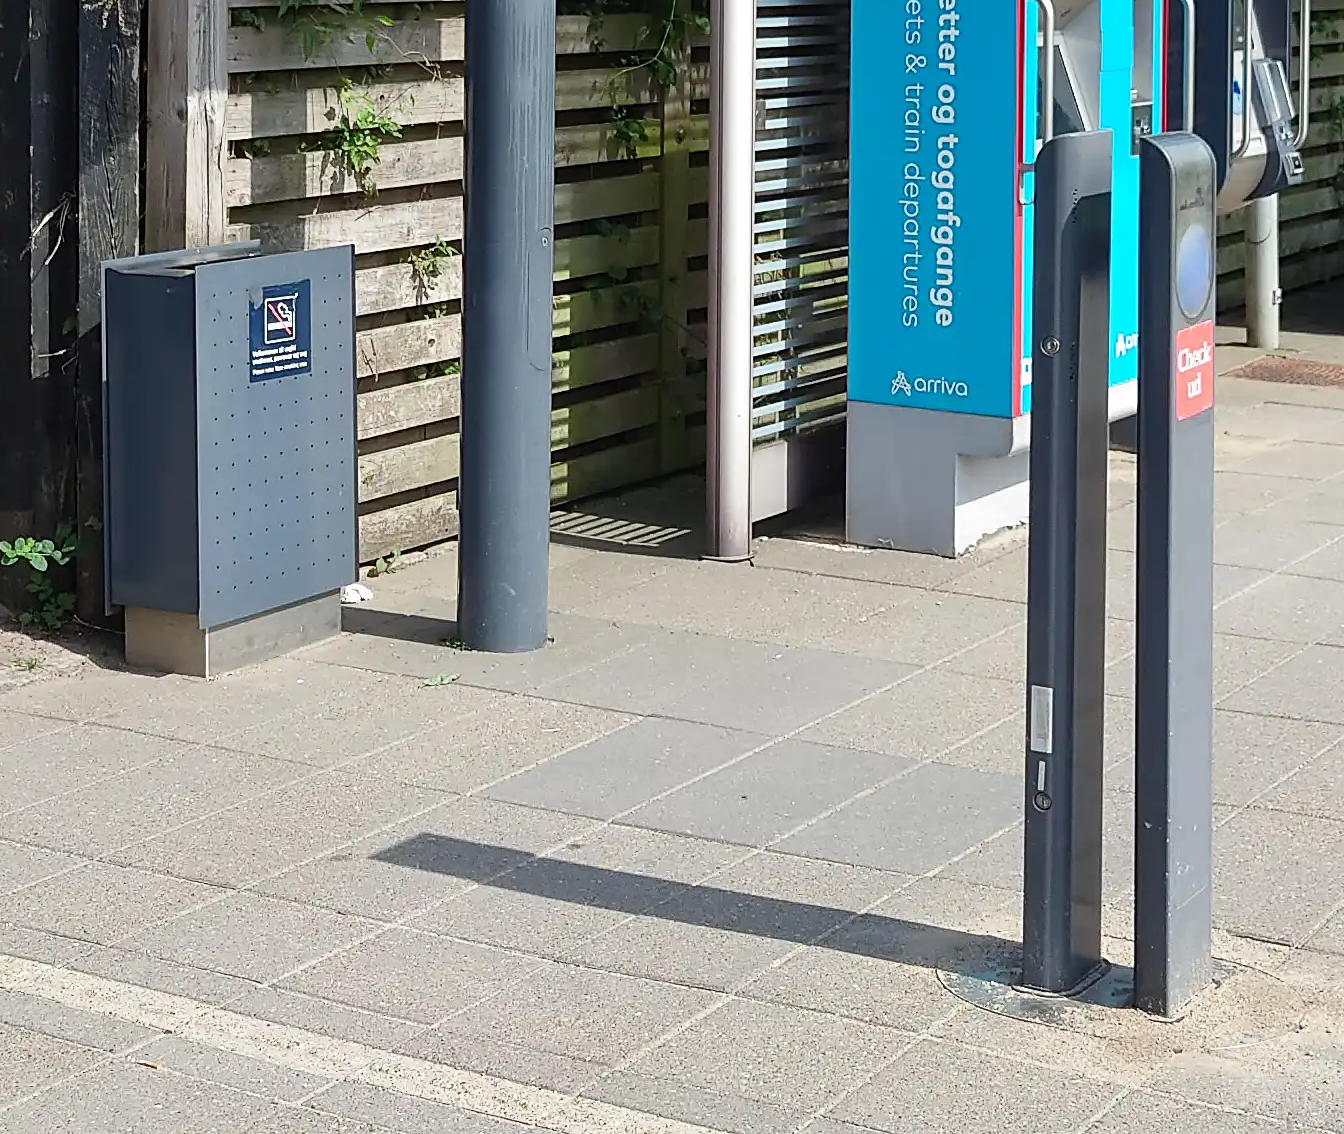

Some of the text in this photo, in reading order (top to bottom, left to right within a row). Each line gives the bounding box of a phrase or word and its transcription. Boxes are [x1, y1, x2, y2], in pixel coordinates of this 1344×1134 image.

[905, 53, 927, 74] &
[904, 82, 926, 153] train
[931, 83, 956, 124] og
[898, 162, 926, 328] departures
[929, 133, 962, 327] togafgange
[1178, 341, 1212, 373] Check
[914, 377, 968, 397] arriva
[1187, 372, 1202, 398] ud
